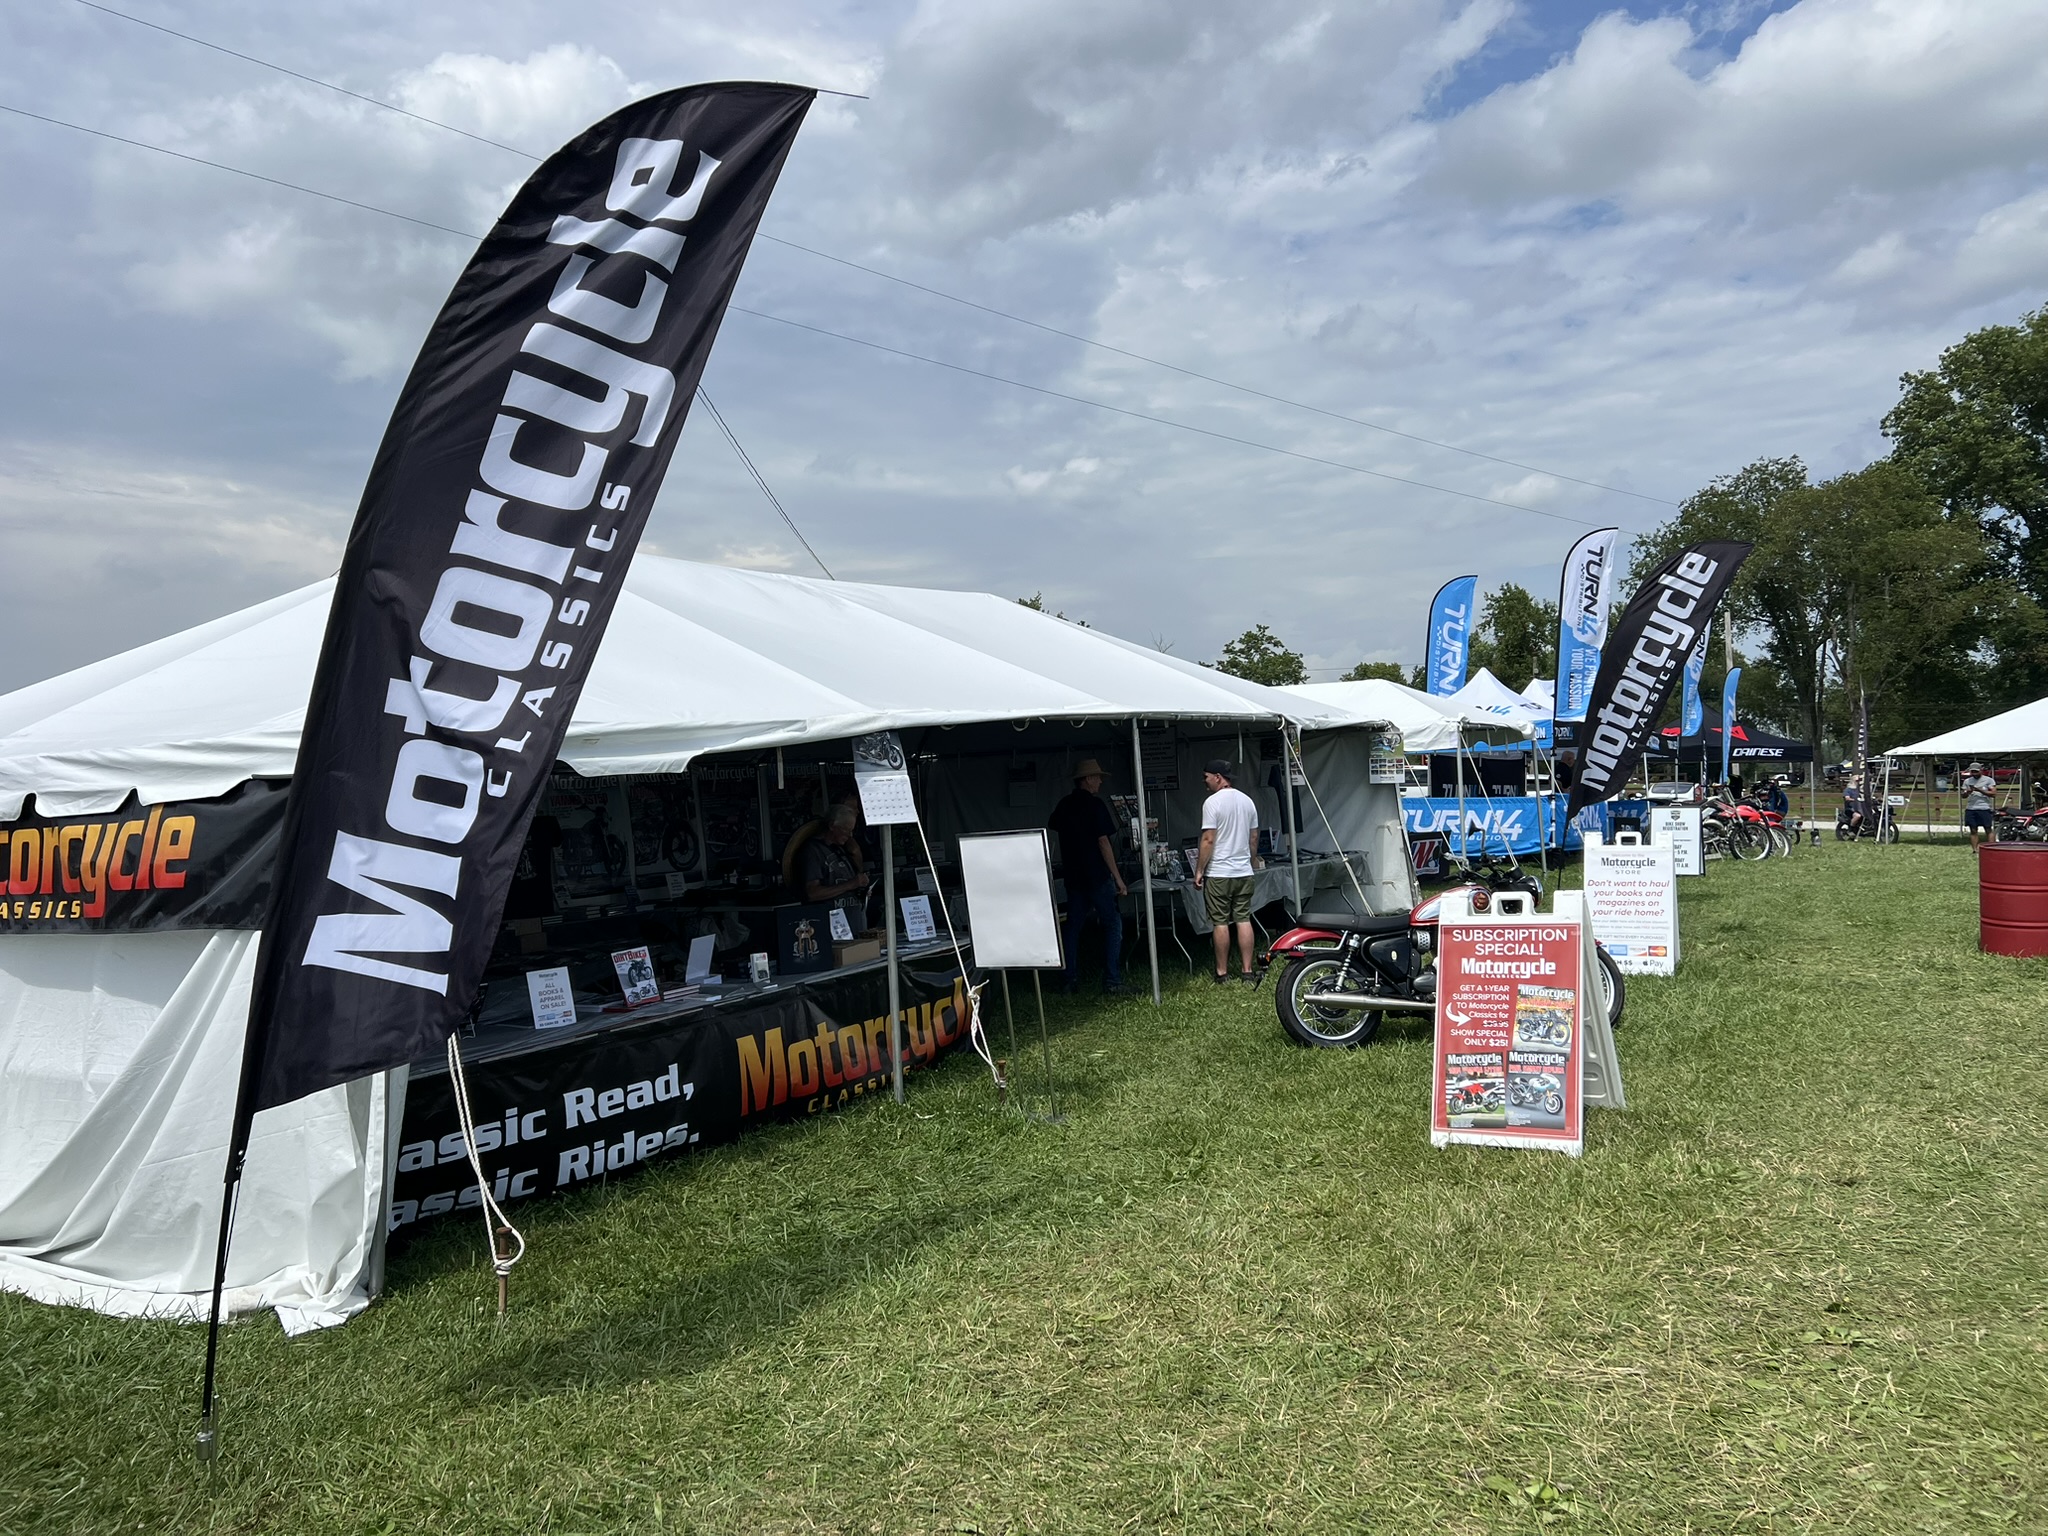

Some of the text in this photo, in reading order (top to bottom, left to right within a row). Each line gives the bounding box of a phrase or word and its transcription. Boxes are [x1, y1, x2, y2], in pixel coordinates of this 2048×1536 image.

[302, 136, 722, 998] Motorcycle
[1577, 545, 1604, 635] TURN14
[485, 480, 631, 799] CLASSICS
[1580, 551, 1719, 793] Motorcycle
[1568, 648, 1584, 710] YOUR PASSION
[1626, 658, 1677, 750] CLASSICS
[1732, 747, 1785, 757] DAINESE
[1601, 857, 1656, 869] Motorcycle
[1649, 880, 1670, 888] haul
[1593, 889, 1614, 897] your
[1615, 889, 1643, 897] books
[1597, 898, 1646, 908] magazines
[1592, 909, 1613, 917] your
[1634, 909, 1665, 917] home?
[1452, 928, 1568, 942] SUBSCRIPTION
[1474, 943, 1543, 956] SPECIAL!
[1460, 957, 1556, 979] Motorcycle
[1649, 959, 1664, 968] Pay
[538, 988, 559, 997] BOOKS
[1459, 984, 1510, 992] GET A 1-YEAR
[1519, 985, 1575, 1000] Motorcycle
[540, 994, 565, 1003] APPAREL
[1452, 993, 1510, 1001] SUBSCRIPTION
[1456, 1001, 1467, 1009] TO
[1468, 1002, 1510, 1010] Motorcycle
[1468, 1010, 1509, 1019] Classics for
[1450, 1028, 1509, 1038] SHOW SPECIAL
[736, 976, 984, 1116] Motorcycl
[1463, 1038, 1509, 1047] ONLY $25!
[1447, 1053, 1502, 1066] Motorcycle
[1508, 1051, 1566, 1066] Motorcycle
[563, 1062, 695, 1129] Read,
[556, 1122, 700, 1187] Rides.
